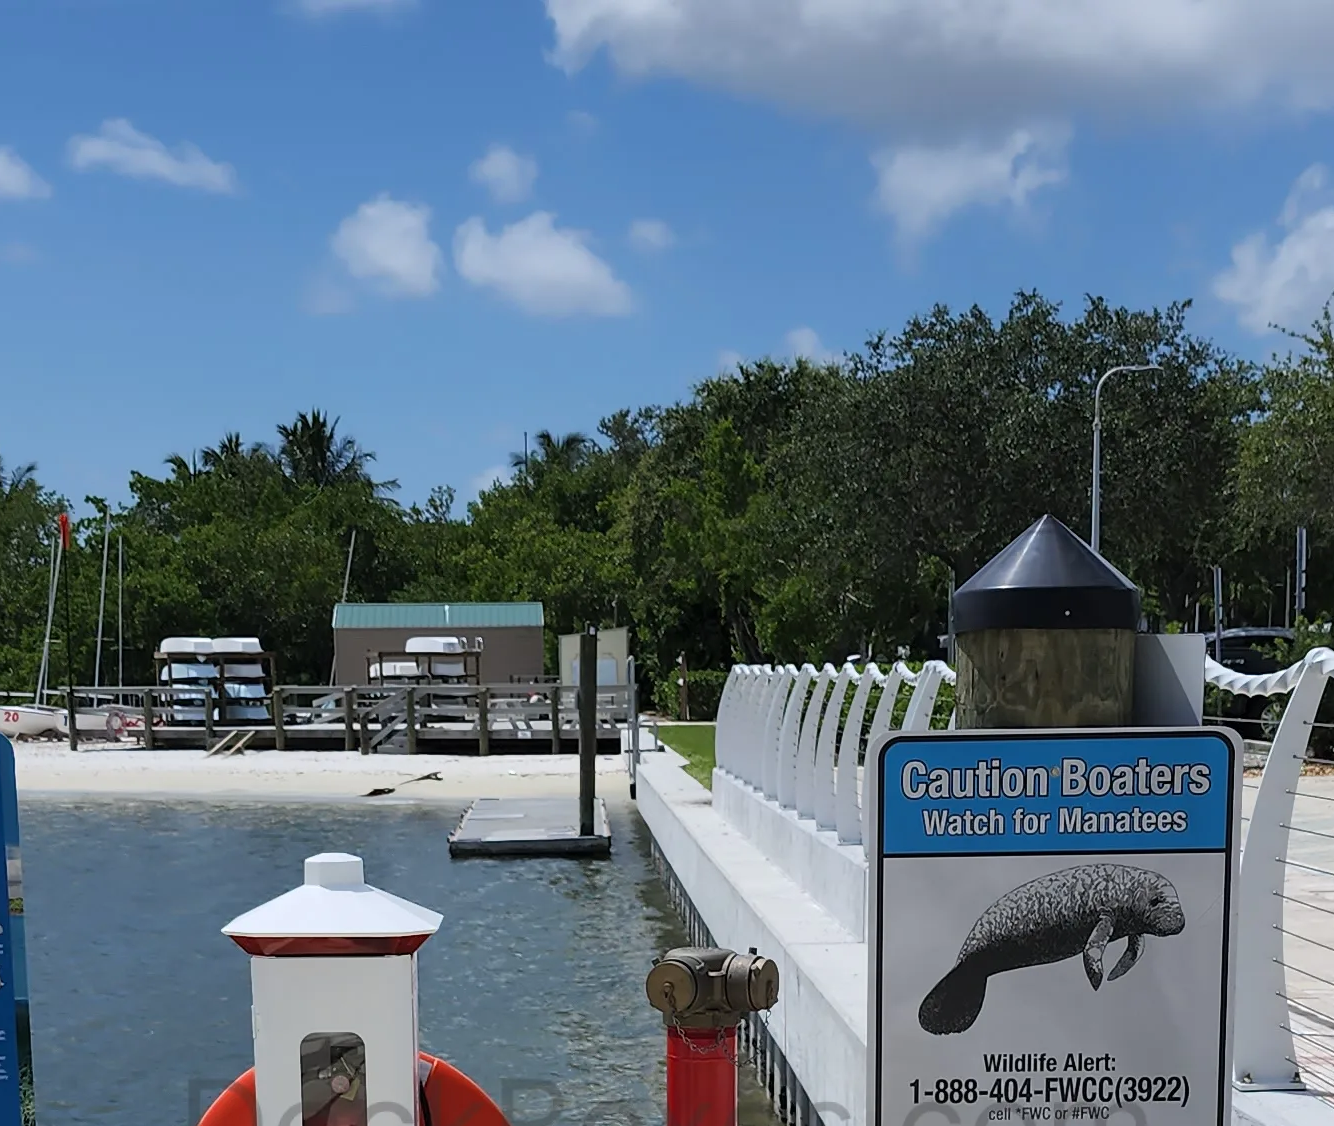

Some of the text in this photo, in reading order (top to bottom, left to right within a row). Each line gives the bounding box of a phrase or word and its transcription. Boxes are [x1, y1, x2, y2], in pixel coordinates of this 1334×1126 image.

[4, 711, 19, 722] 20
[901, 757, 1211, 799] Caution Boaters
[922, 807, 1187, 836] Watch for Manatees
[983, 1053, 1116, 1073] Wildlife Alert:
[909, 1076, 1190, 1108] 1-888-404-FWCC(3922)
[988, 1107, 1011, 1121] cell
[1055, 1110, 1068, 1120] or
[1071, 1106, 1110, 1120] #FWC
